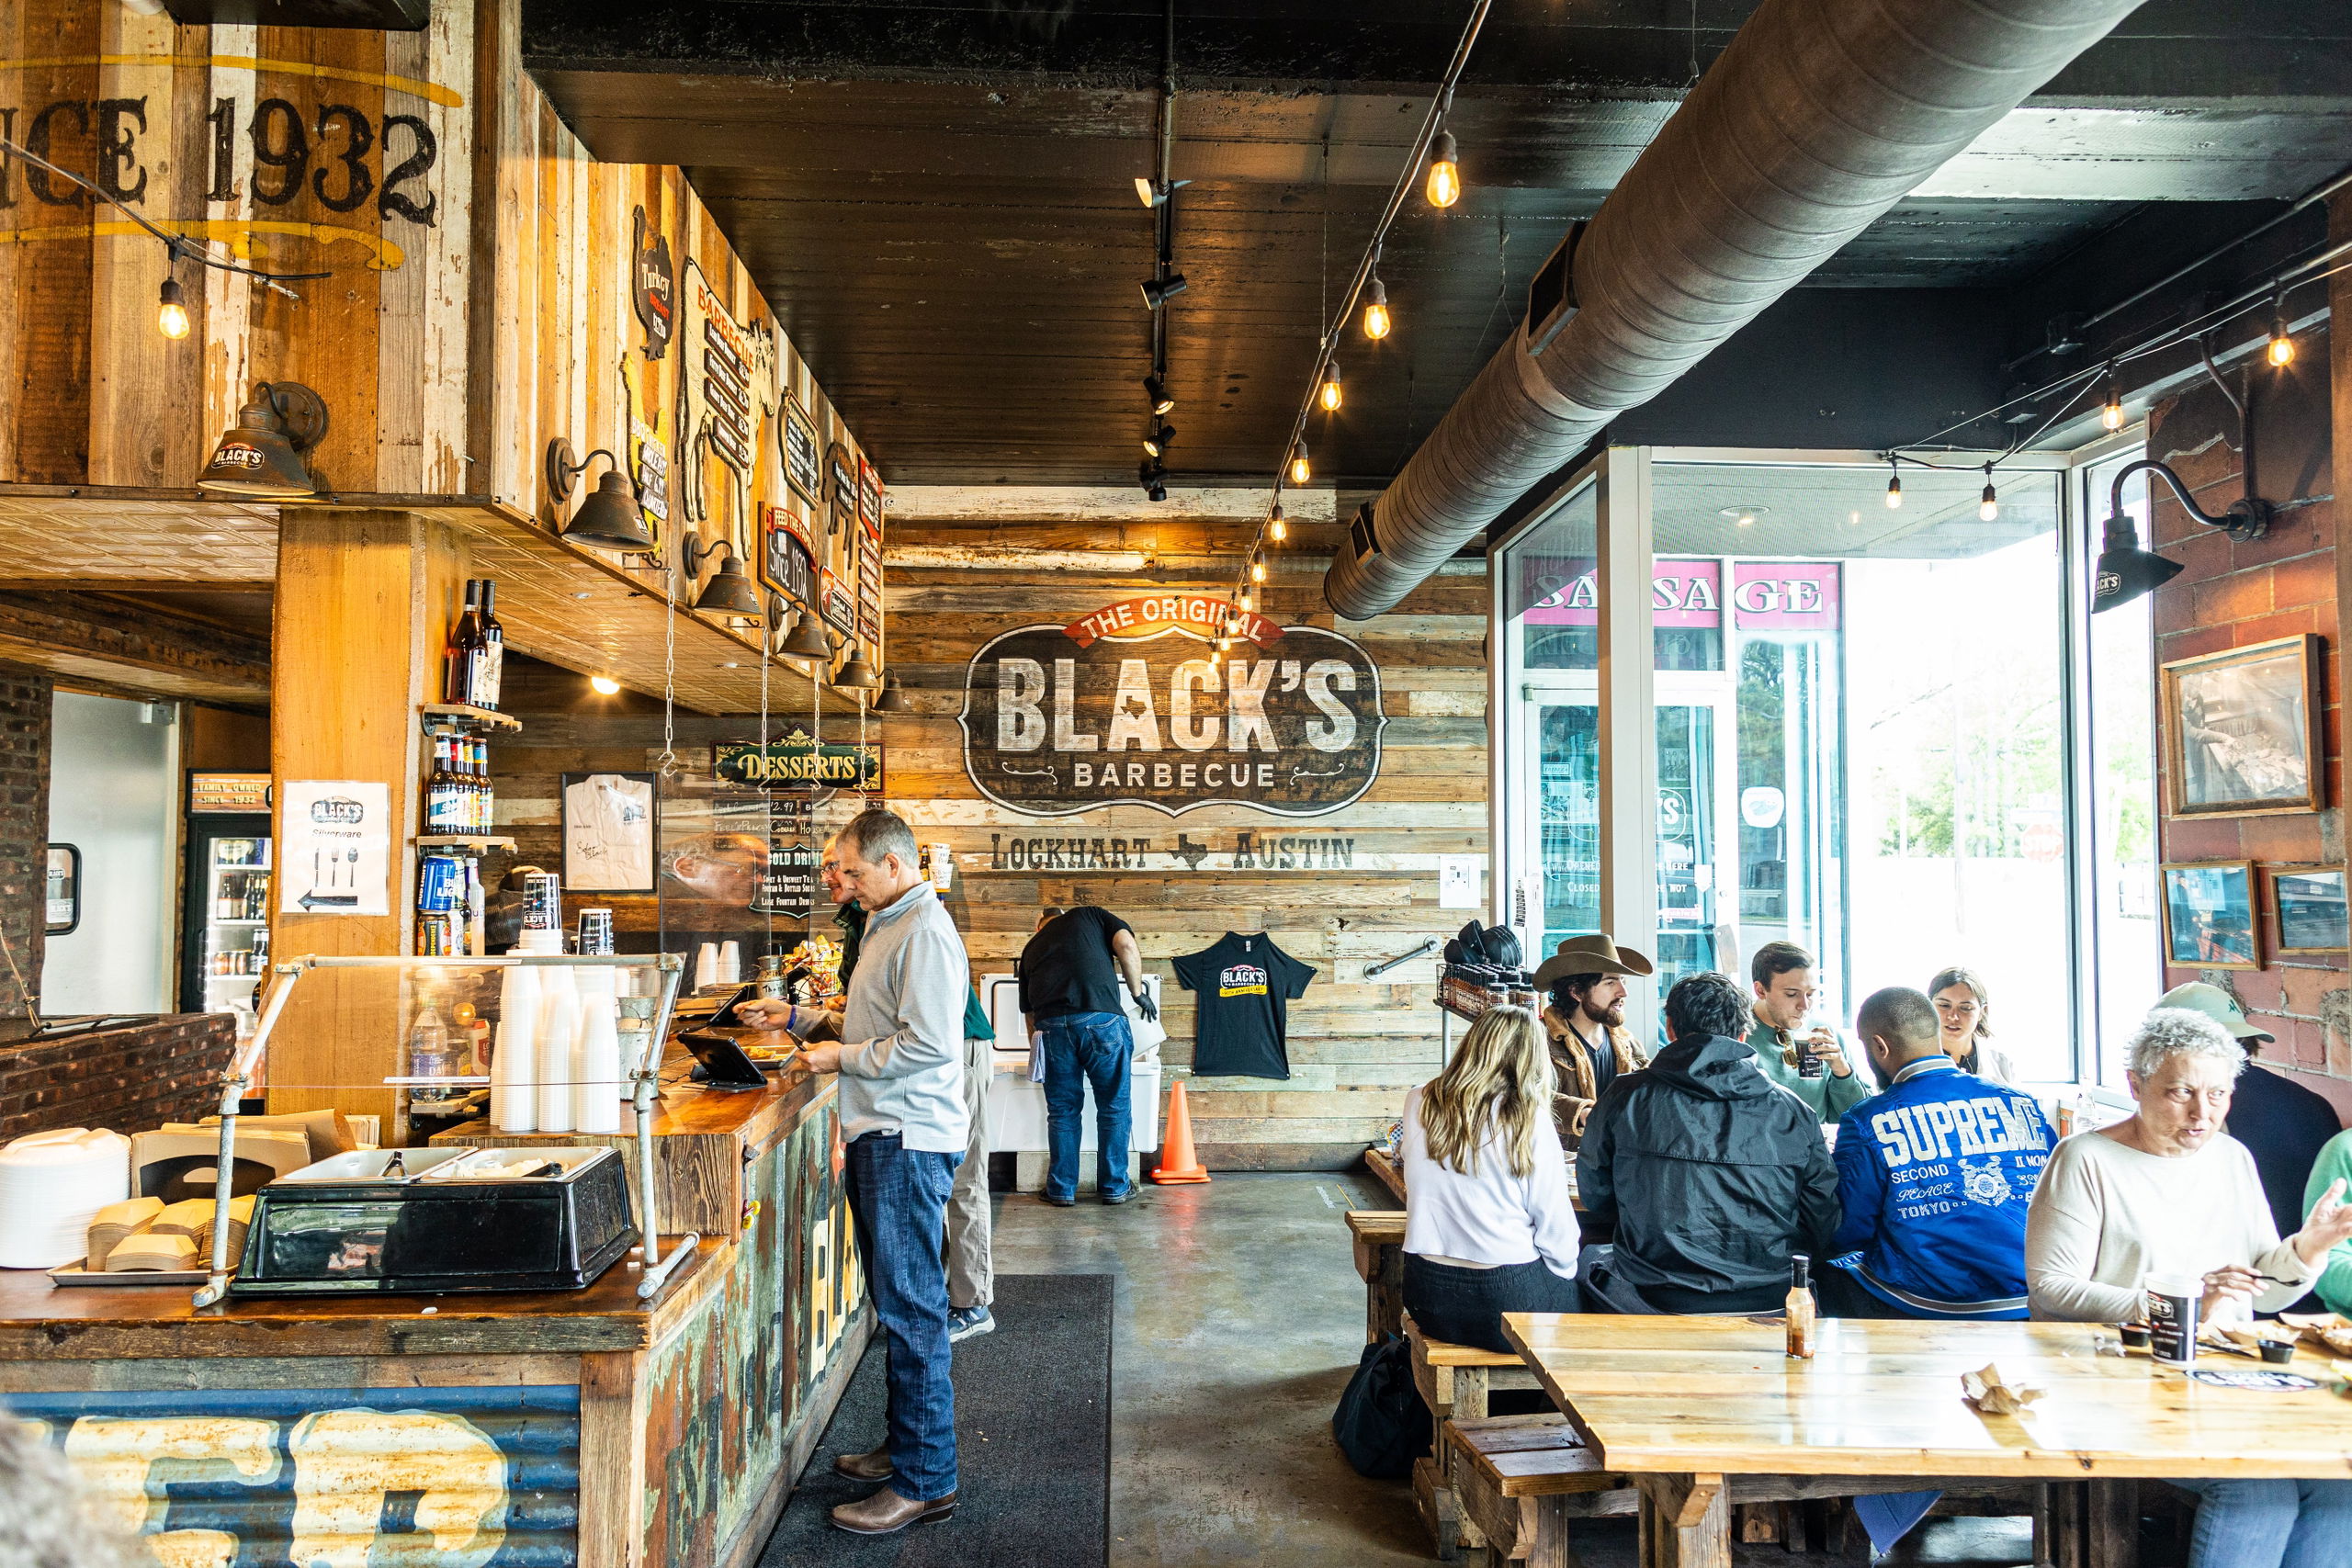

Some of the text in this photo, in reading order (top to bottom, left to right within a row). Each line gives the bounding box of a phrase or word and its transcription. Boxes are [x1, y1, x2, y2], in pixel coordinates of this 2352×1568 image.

[206, 97, 438, 228] 1932
[641, 263, 670, 301] Turkey
[698, 284, 753, 375] BARBECUE
[214, 449, 262, 464] BLACK'S
[775, 510, 788, 525] FEED
[788, 514, 798, 533] THE
[769, 534, 790, 588] Since
[1080, 604, 1136, 639] THE
[997, 658, 1356, 752] BLACK'S
[737, 753, 856, 780] DESSERTS
[1073, 762, 1275, 788] BARBECUE
[198, 784, 262, 793] FAMILY OWNED
[201, 795, 257, 805] SINCE 1932
[313, 803, 363, 818] BLACK'S
[312, 829, 362, 839] Silverware
[767, 852, 791, 865] COLD
[990, 833, 1151, 871] LOCKHART
[1233, 833, 1355, 870] AUSTIN
[1223, 972, 1264, 983] BLACK'S
[1871, 1097, 2048, 1168] SUPREME
[1891, 1164, 1949, 1184] SECOND
[1898, 1201, 1951, 1219] TOKYO
